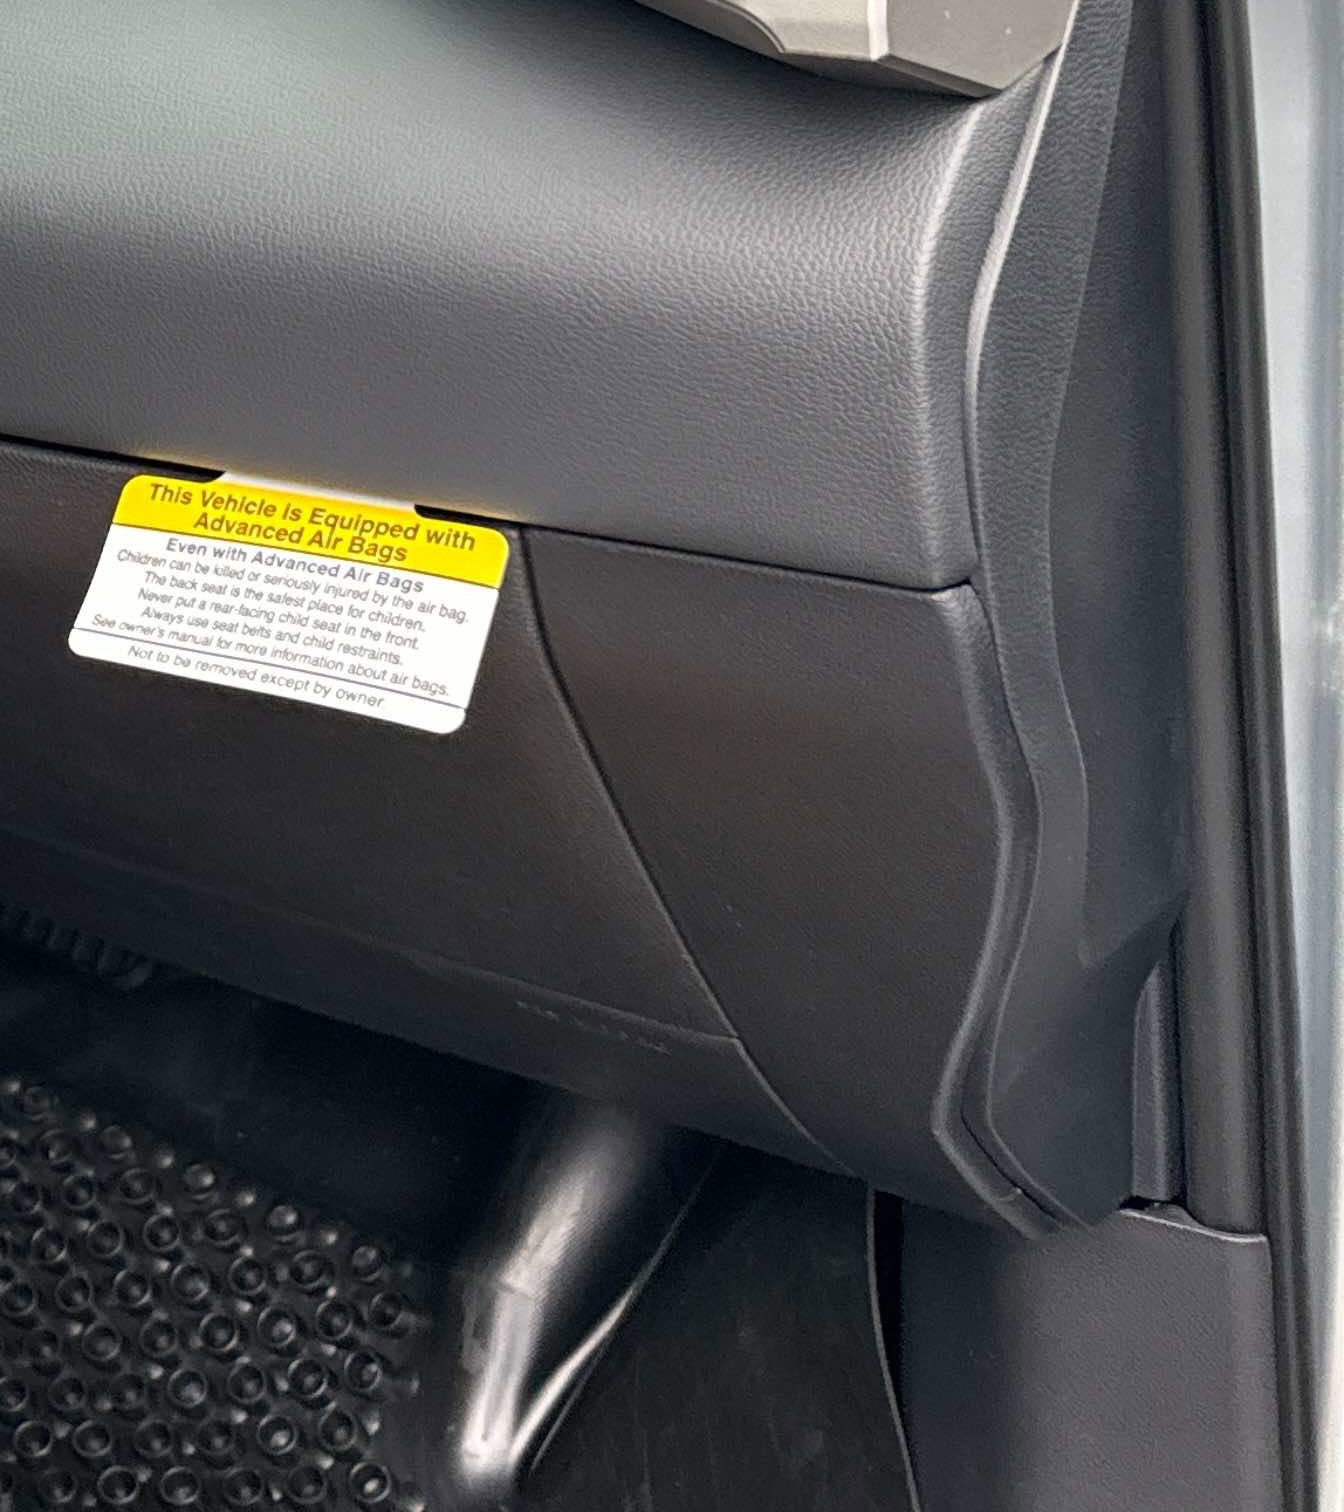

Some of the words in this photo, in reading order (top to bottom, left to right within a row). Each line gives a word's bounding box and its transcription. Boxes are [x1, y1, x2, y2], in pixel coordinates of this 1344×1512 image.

[150, 483, 193, 505] This
[200, 490, 277, 517] Vehicle
[282, 503, 303, 522] is
[308, 507, 420, 541] Equipped
[425, 528, 476, 551] with
[193, 512, 304, 544] Advanced
[307, 530, 343, 551] Air
[348, 535, 408, 563] Bags
[117, 548, 167, 568] Children
[169, 557, 192, 573] can
[194, 560, 210, 575] be
[213, 563, 246, 581] killed
[247, 571, 261, 583] or
[263, 574, 321, 594] seriously
[323, 584, 370, 602] injured
[371, 590, 388, 607] by
[391, 593, 414, 610] the
[417, 601, 436, 615] air
[438, 603, 469, 625] bag.
[166, 537, 207, 556] Even
[212, 545, 247, 562] with
[250, 551, 340, 577] Advanced
[343, 566, 371, 583] Air
[375, 571, 424, 593] Bags
[137, 588, 172, 604] Never
[174, 594, 197, 610] put
[198, 599, 207, 611] a
[209, 600, 276, 624] rear-facing
[278, 610, 309, 628] child
[311, 617, 342, 633] seat
[344, 622, 356, 636] in
[360, 625, 382, 641] the
[384, 631, 419, 650] front.
[144, 571, 167, 586] The
[170, 575, 197, 591] back
[201, 580, 228, 596] seat
[230, 585, 240, 598] is
[243, 587, 263, 601] the
[266, 590, 306, 608] safest
[307, 597, 344, 615] place
[347, 605, 366, 619] for
[367, 609, 426, 633] children.
[91, 614, 116, 629] See
[118, 619, 164, 638] owner's
[167, 630, 213, 648] manual
[216, 635, 234, 650] for
[234, 643, 267, 657] more
[270, 645, 344, 672] information
[347, 664, 388, 682] about
[390, 672, 409, 686] air
[412, 676, 449, 696] bags.
[141, 606, 184, 625] Always
[186, 615, 209, 627] use
[211, 617, 239, 634] seat
[241, 623, 272, 639] belts
[275, 630, 300, 645] and
[302, 634, 334, 651] child
[337, 641, 404, 666] restraints.
[128, 645, 154, 660] Not
[155, 651, 170, 664] to
[173, 655, 192, 668] be
[195, 659, 258, 681] removed
[260, 672, 310, 691] except
[313, 680, 332, 698] by
[335, 687, 385, 708] owner
